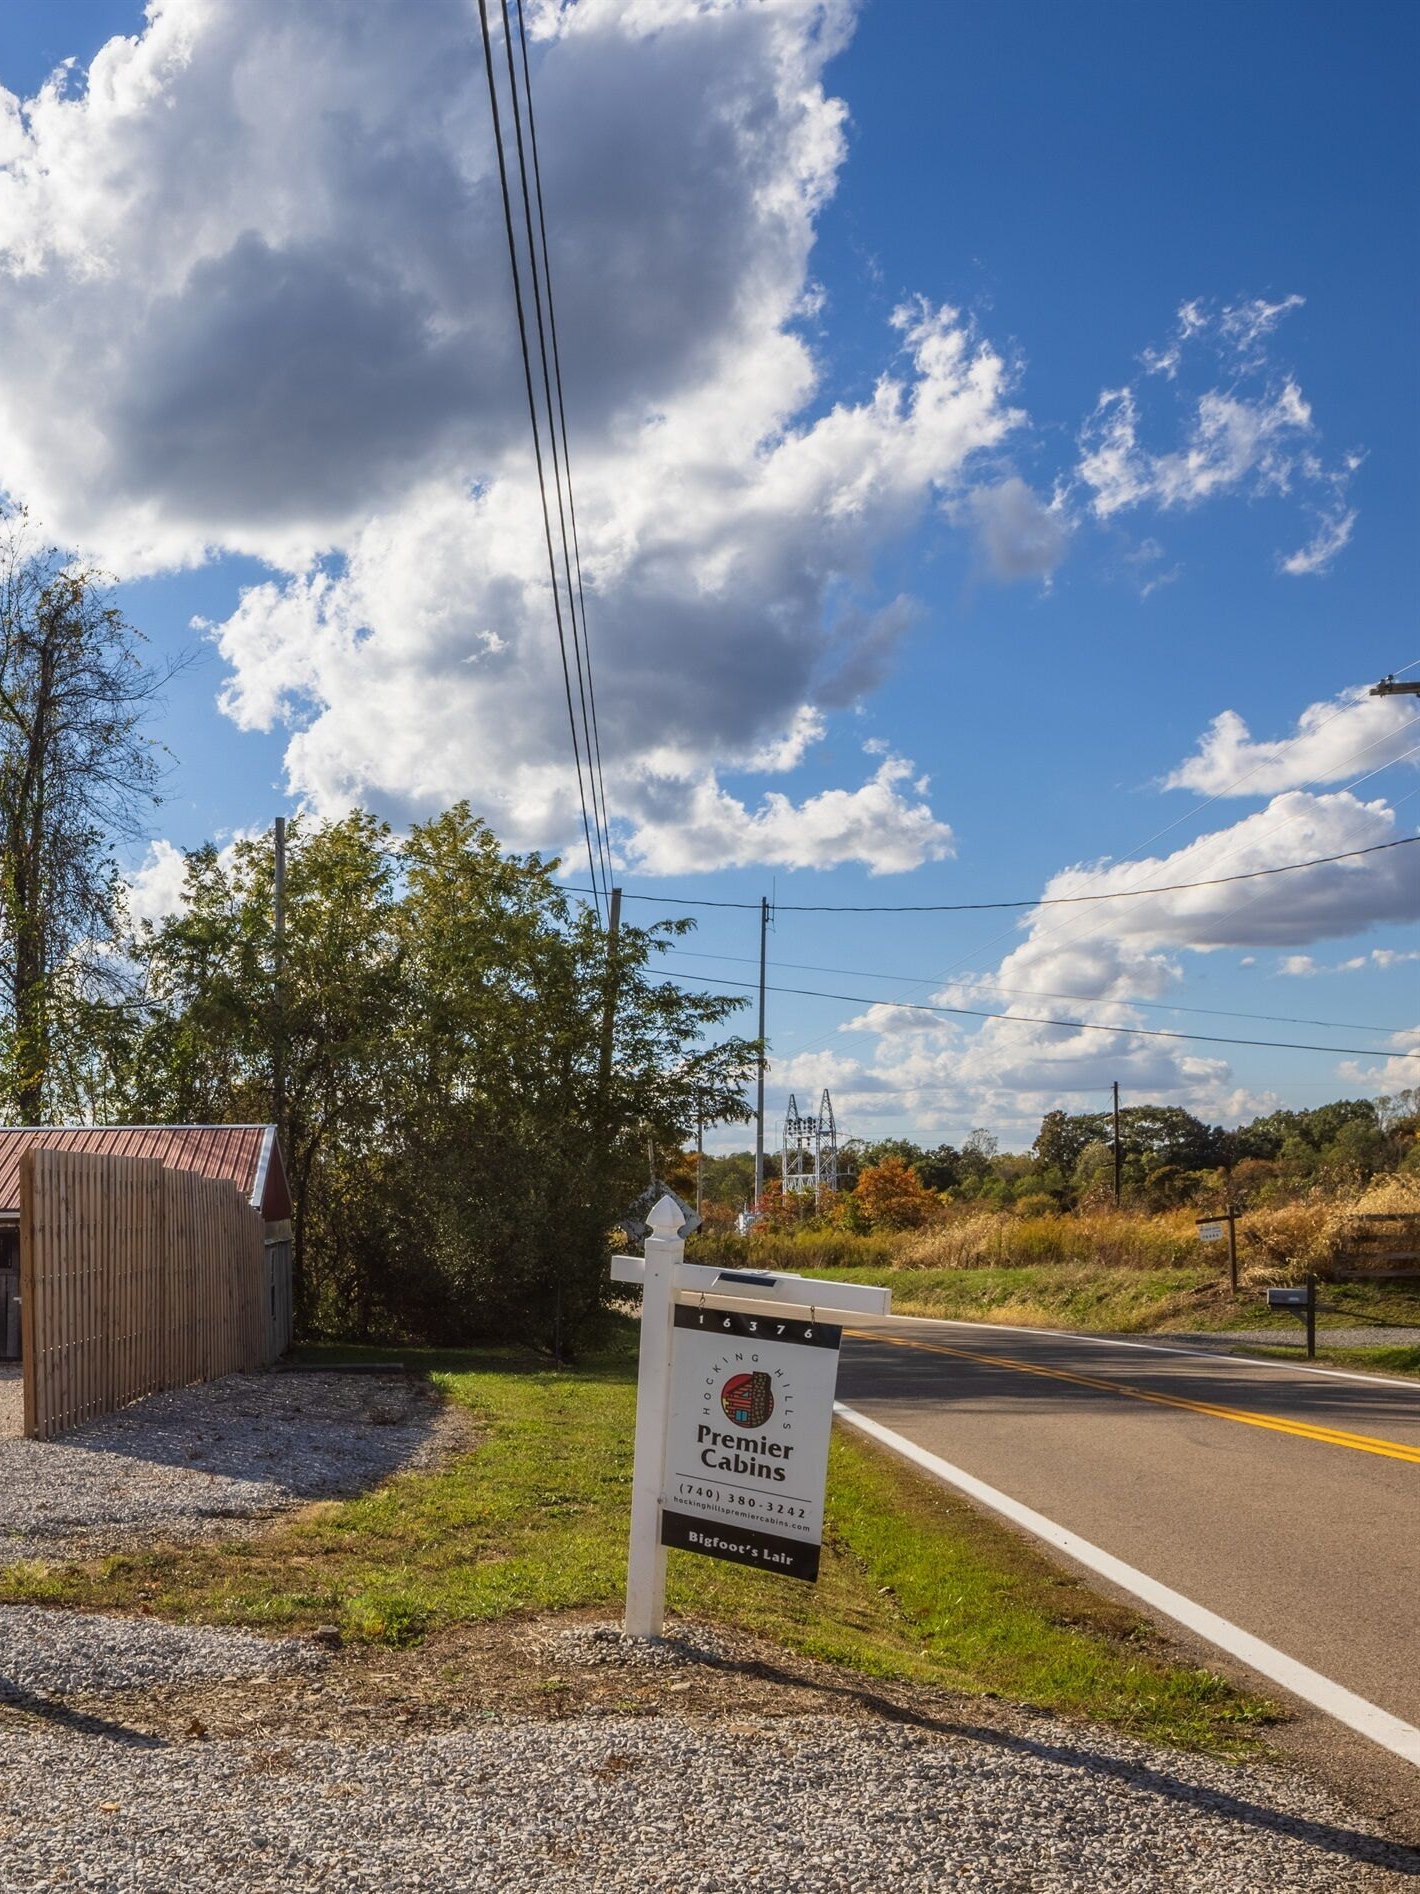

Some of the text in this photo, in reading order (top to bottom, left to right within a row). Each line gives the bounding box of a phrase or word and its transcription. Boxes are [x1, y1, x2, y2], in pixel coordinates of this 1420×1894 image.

[699, 1314, 813, 1339] 16376
[703, 1353, 794, 1430] HOCKING HILLS
[697, 1424, 794, 1460] Premier
[701, 1449, 787, 1482] Cabins
[673, 1495, 811, 1532] hockinghillspremiercabins.com
[679, 1483, 806, 1519] (740) 380-3242
[688, 1531, 794, 1566] Bigfoot's Lair
